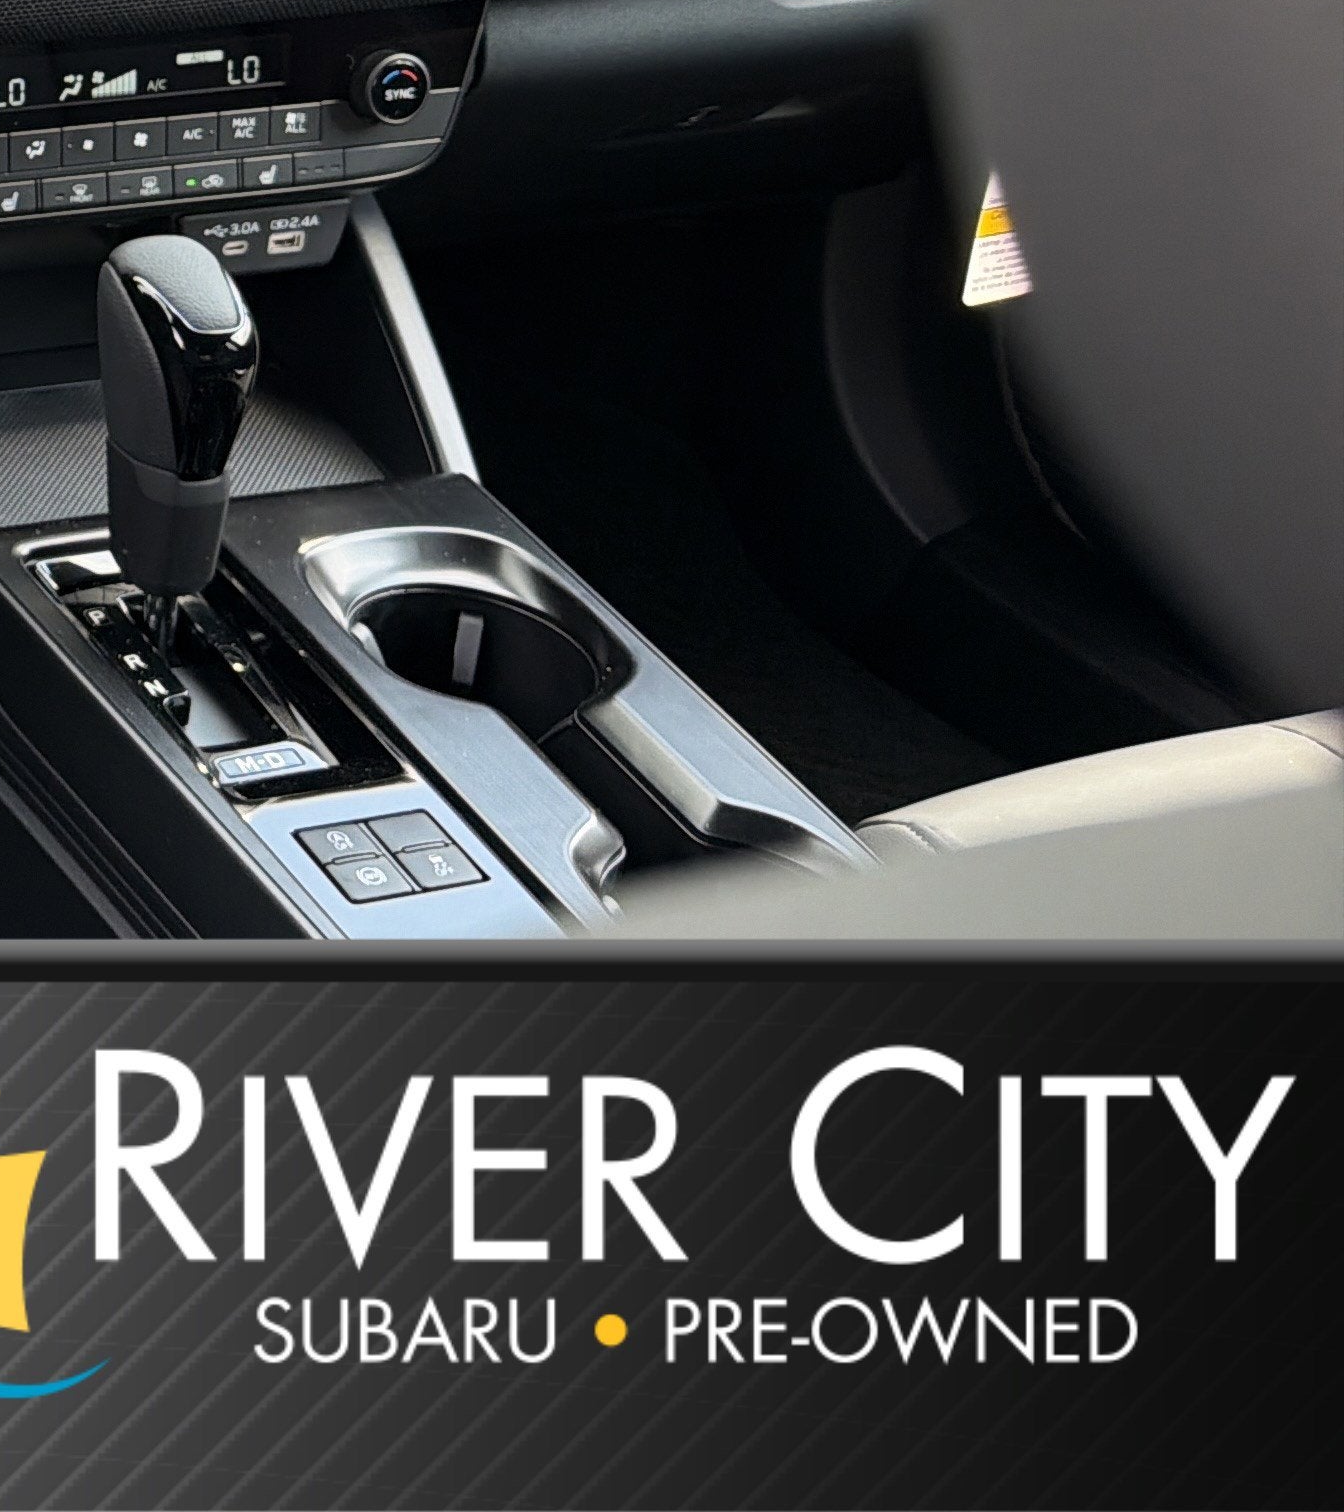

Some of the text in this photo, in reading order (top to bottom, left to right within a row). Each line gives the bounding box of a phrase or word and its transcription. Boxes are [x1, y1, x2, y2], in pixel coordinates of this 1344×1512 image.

[227, 55, 261, 85] LO
[146, 78, 168, 92] A/C
[384, 87, 417, 102] SYNC
[232, 116, 256, 129] MAX
[182, 127, 203, 141] A/C
[234, 127, 255, 139] A/C
[229, 221, 261, 237] 3.0A
[289, 214, 320, 229] 2.4A
[88, 609, 105, 626] P
[123, 654, 148, 671] R
[143, 679, 169, 697] N
